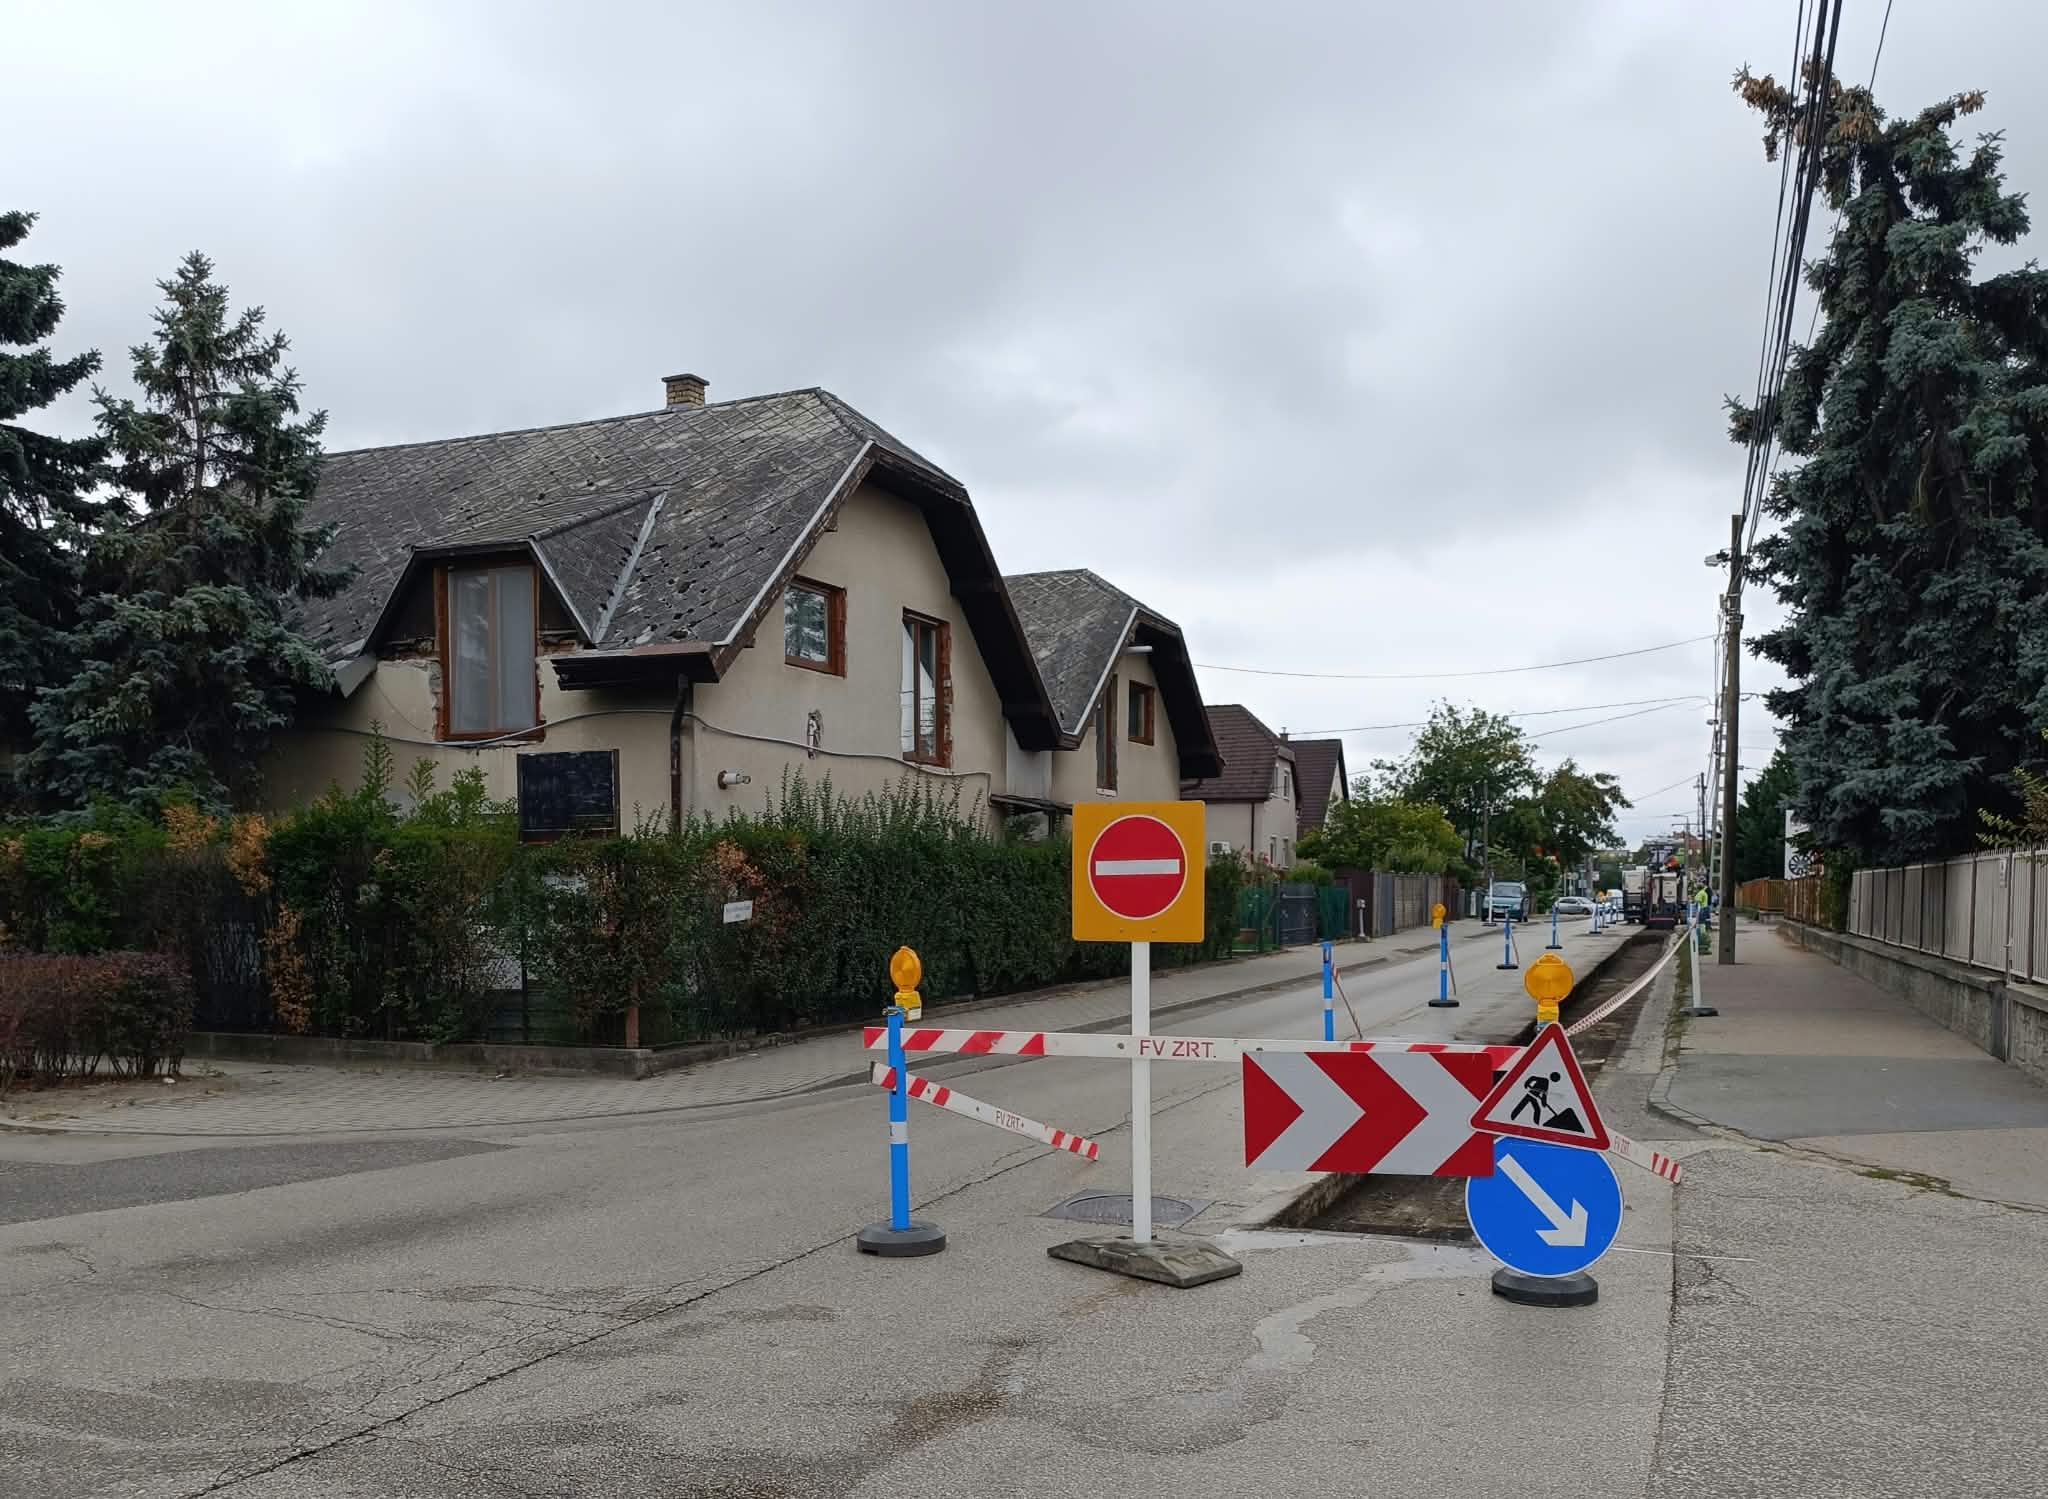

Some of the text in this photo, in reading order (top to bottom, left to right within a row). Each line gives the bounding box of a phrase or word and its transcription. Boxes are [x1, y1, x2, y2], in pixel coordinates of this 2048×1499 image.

[1139, 1039, 1217, 1058] FV ZRT.
[995, 1110, 1006, 1126] FV
